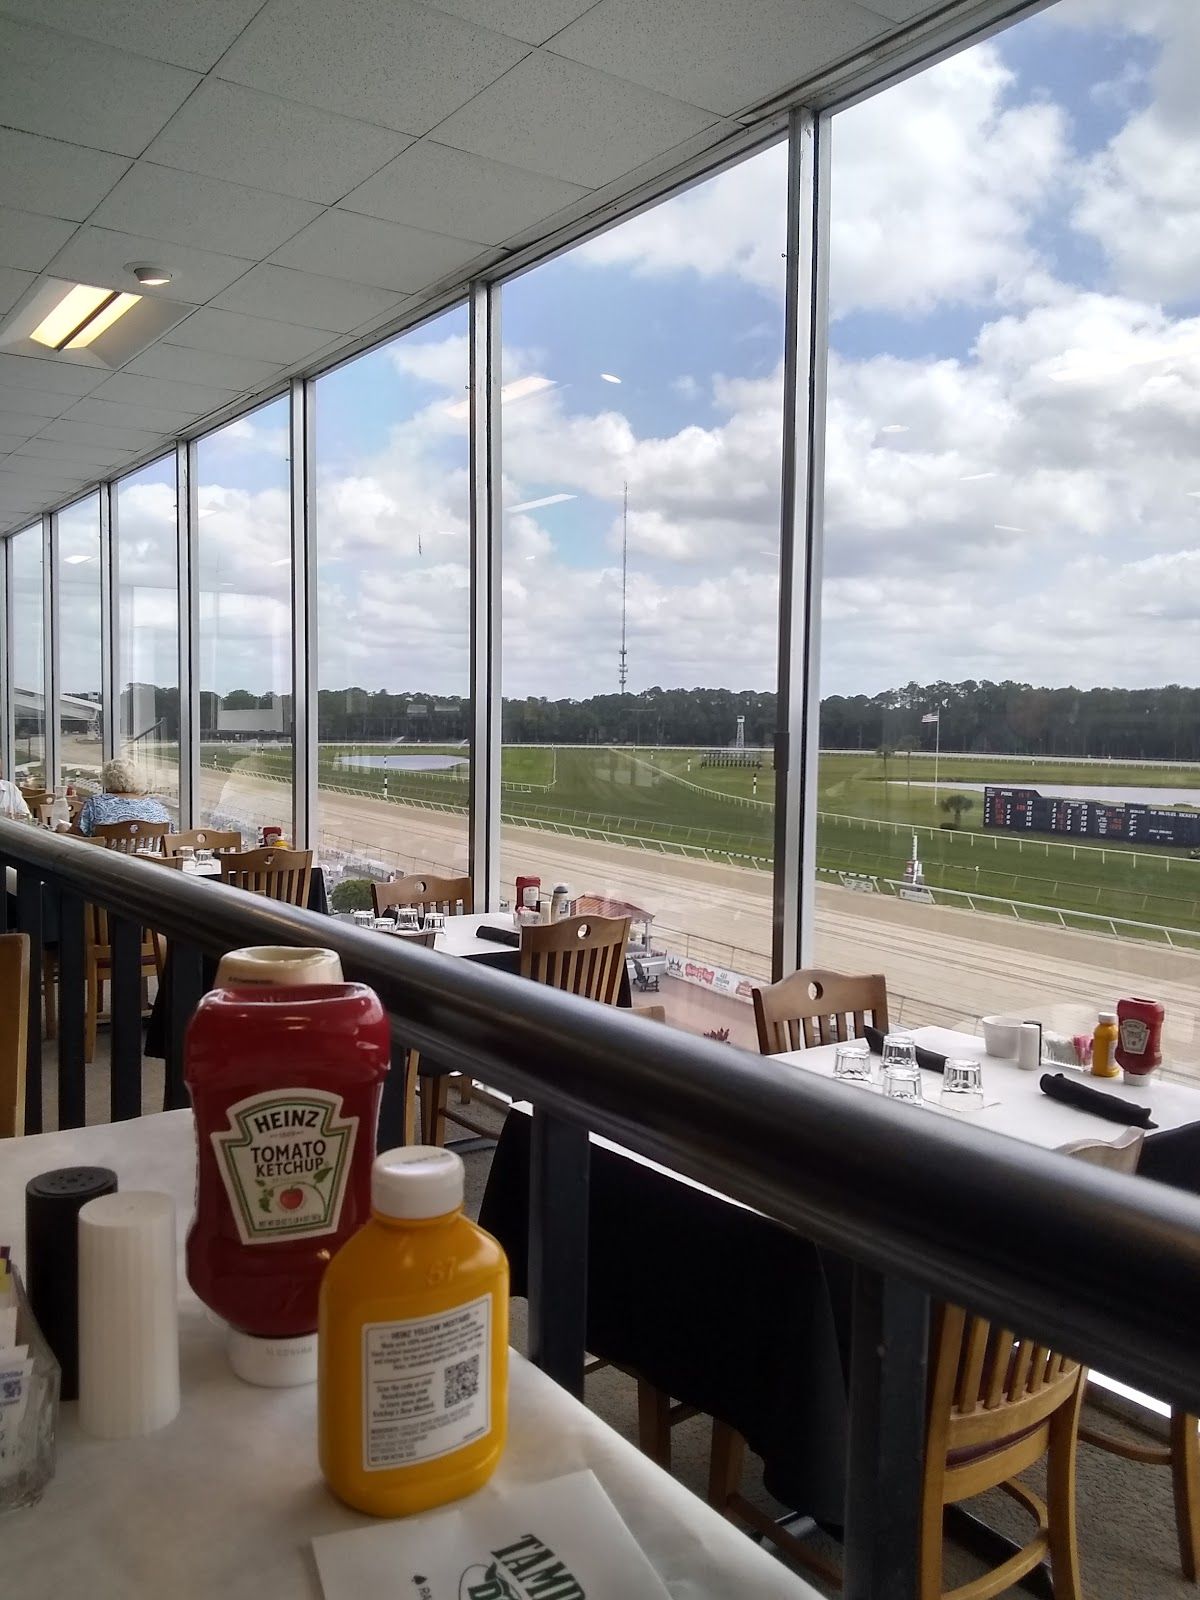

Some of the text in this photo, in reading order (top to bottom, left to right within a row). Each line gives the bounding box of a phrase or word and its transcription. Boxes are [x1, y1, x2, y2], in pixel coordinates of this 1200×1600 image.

[254, 1109, 319, 1134] HEINZ
[250, 1140, 326, 1164] TOMATO
[256, 1157, 324, 1178] KETCHUP
